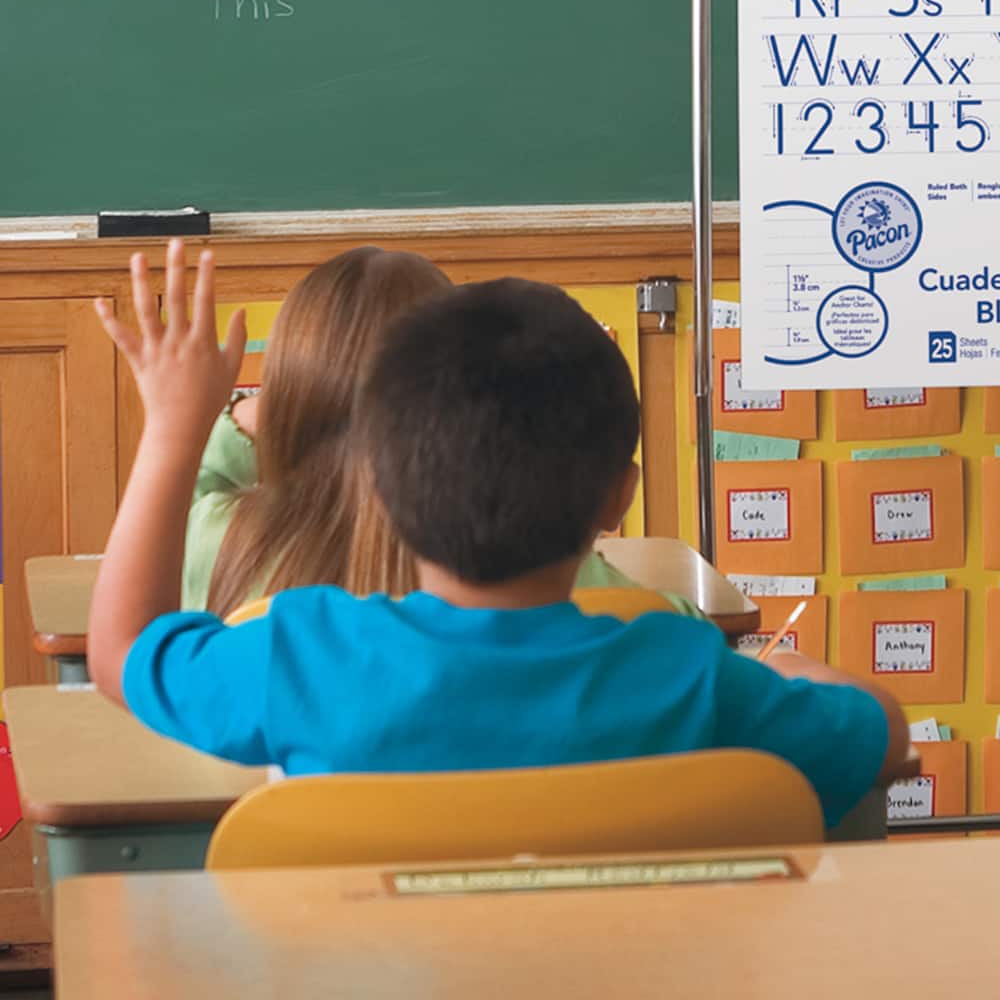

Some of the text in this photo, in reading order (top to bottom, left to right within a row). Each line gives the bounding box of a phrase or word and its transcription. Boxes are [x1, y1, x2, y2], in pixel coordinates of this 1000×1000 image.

[769, 34, 881, 86] Ww
[903, 33, 972, 84] Xx
[776, 102, 786, 155] 1
[802, 102, 835, 154] 2
[855, 102, 887, 153] 3
[908, 102, 940, 153] 4
[955, 101, 986, 152] 5
[846, 223, 909, 256] Pacon
[932, 339, 953, 359] 25
[960, 338, 988, 348] Sheets
